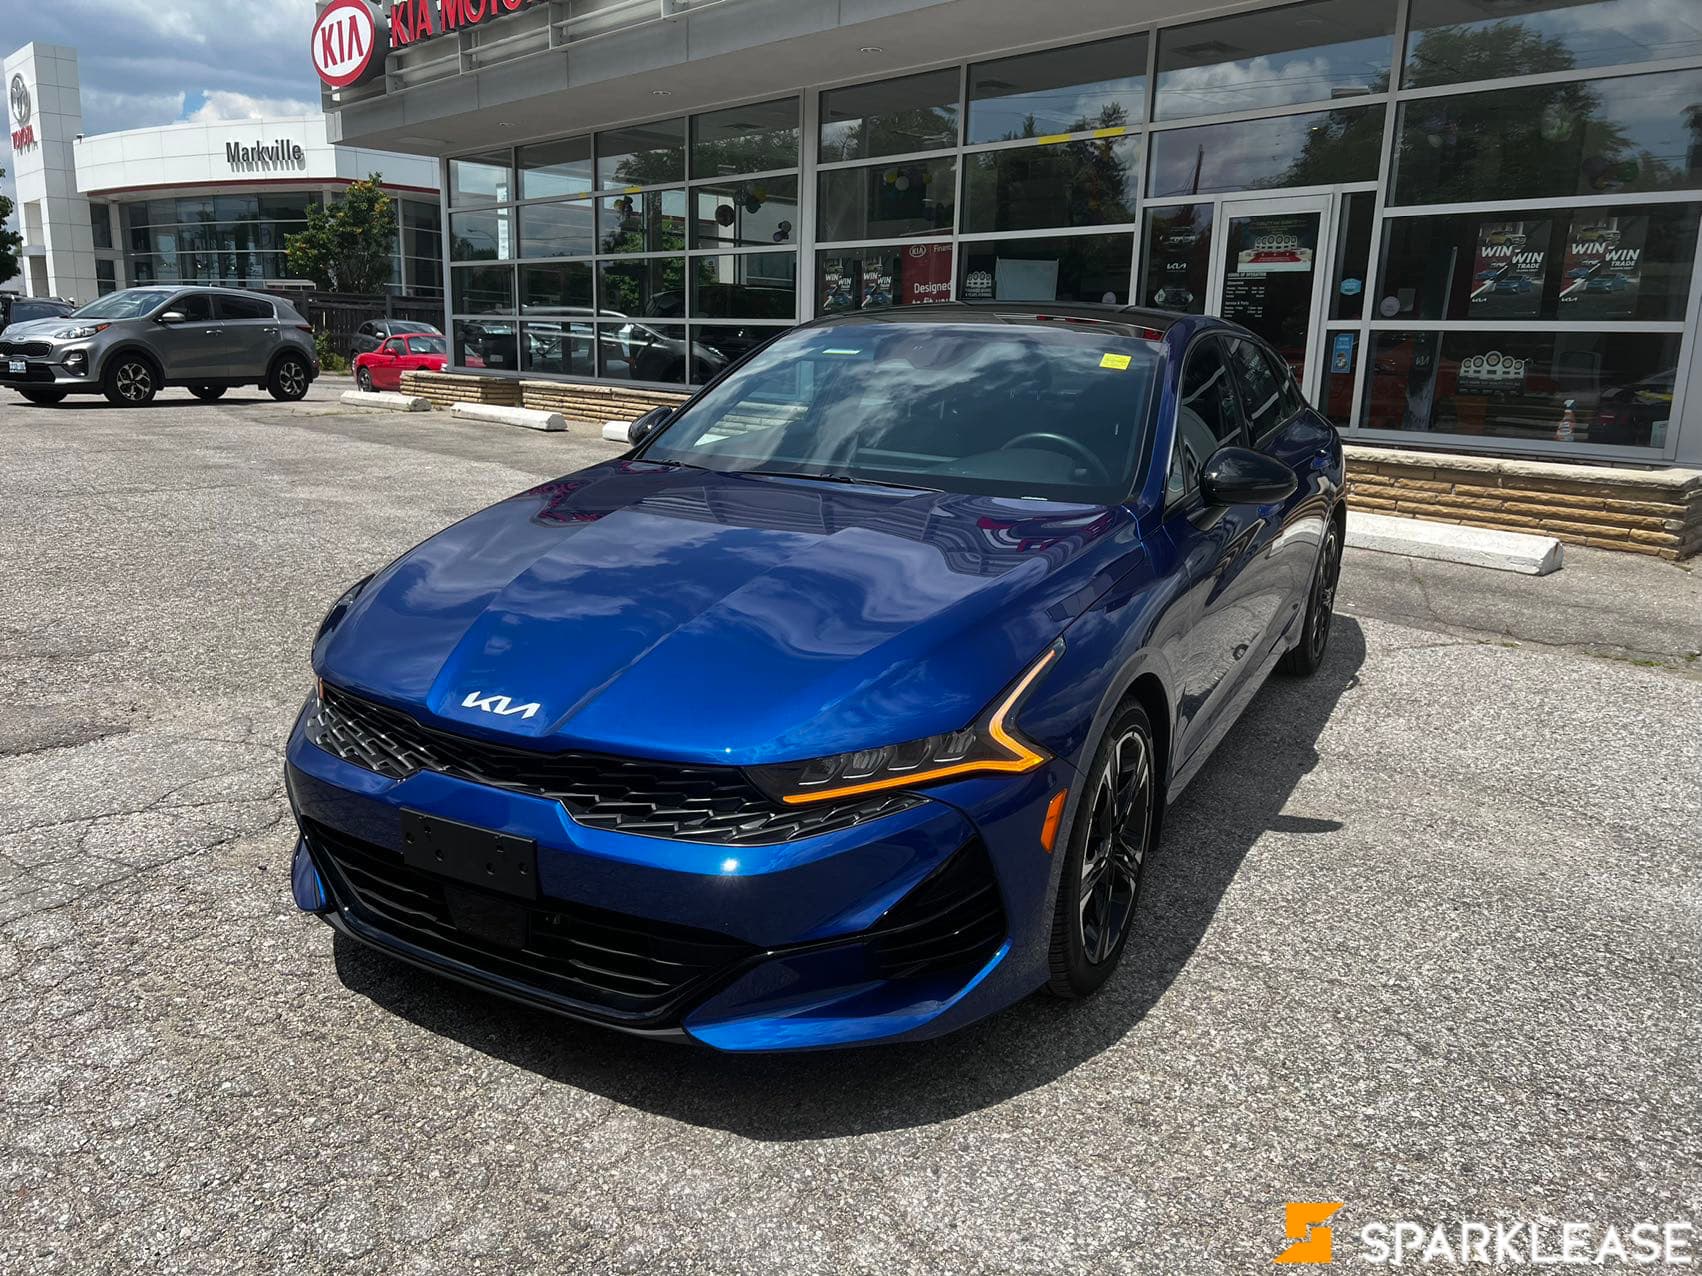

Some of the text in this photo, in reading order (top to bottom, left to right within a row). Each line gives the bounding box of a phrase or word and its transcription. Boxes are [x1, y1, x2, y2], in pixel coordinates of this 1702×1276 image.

[390, 0, 433, 48] KIA
[320, 14, 364, 69] KIA
[11, 124, 35, 150] TOYOTA
[225, 139, 302, 163] Markville
[1512, 252, 1545, 264] WIN
[1605, 249, 1640, 261] WIN
